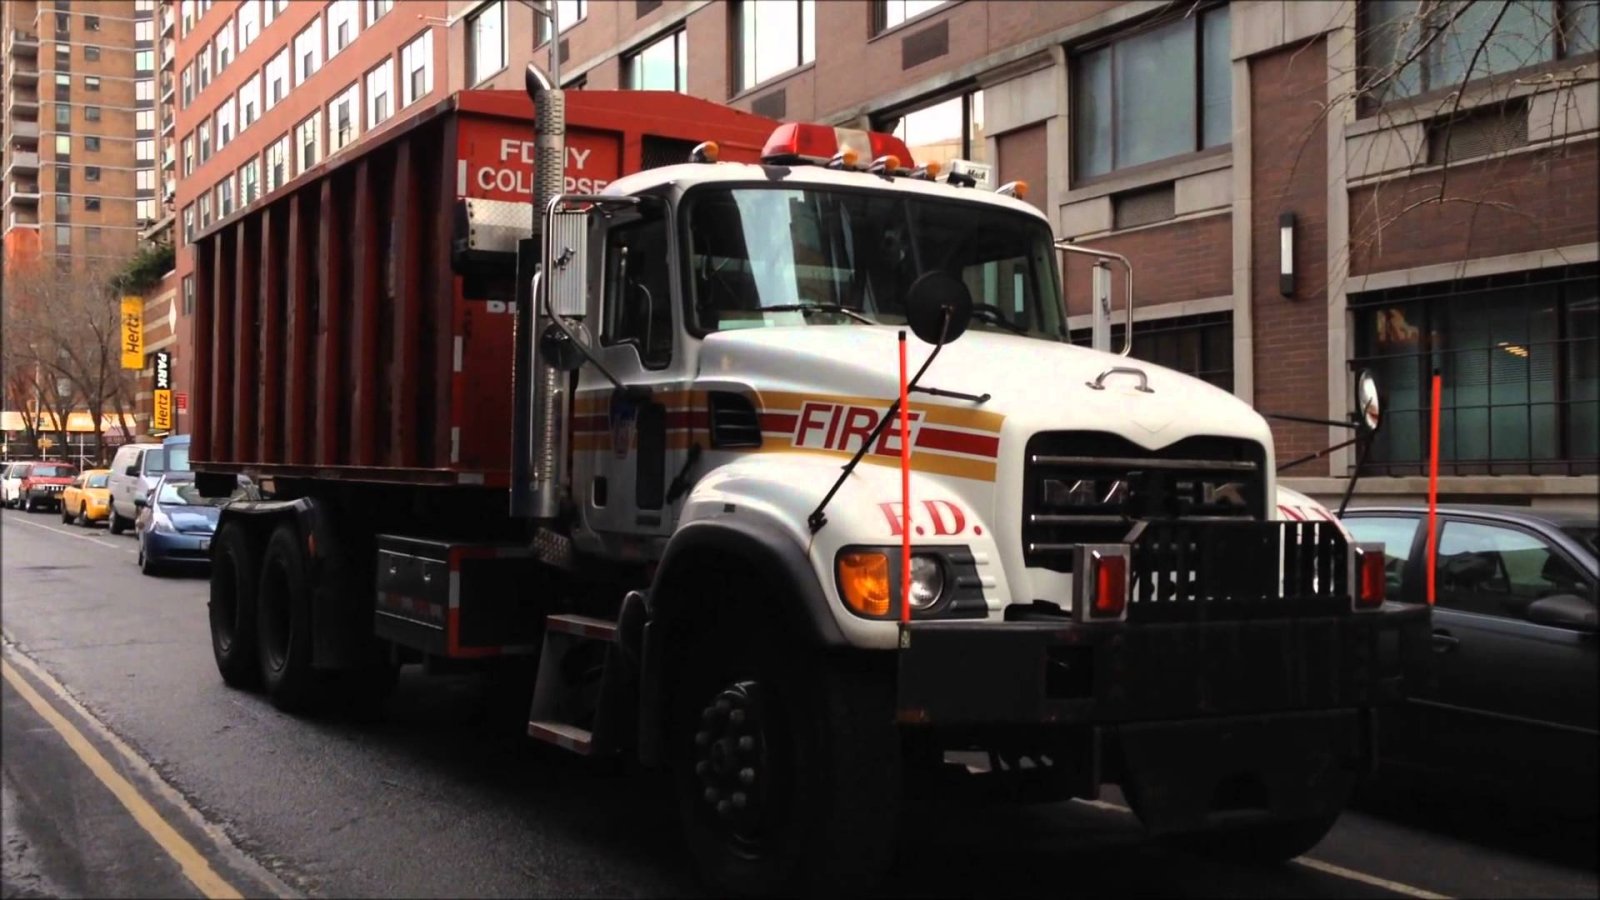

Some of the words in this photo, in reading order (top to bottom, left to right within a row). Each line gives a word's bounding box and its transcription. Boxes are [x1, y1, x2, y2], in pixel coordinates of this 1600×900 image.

[501, 139, 591, 170] FDY
[477, 167, 608, 195] COLPSE
[126, 313, 140, 354] Hertz
[157, 352, 168, 388] PARK
[157, 394, 168, 426] Hertz
[795, 402, 920, 457] FIRE
[878, 500, 982, 536] F.D.
